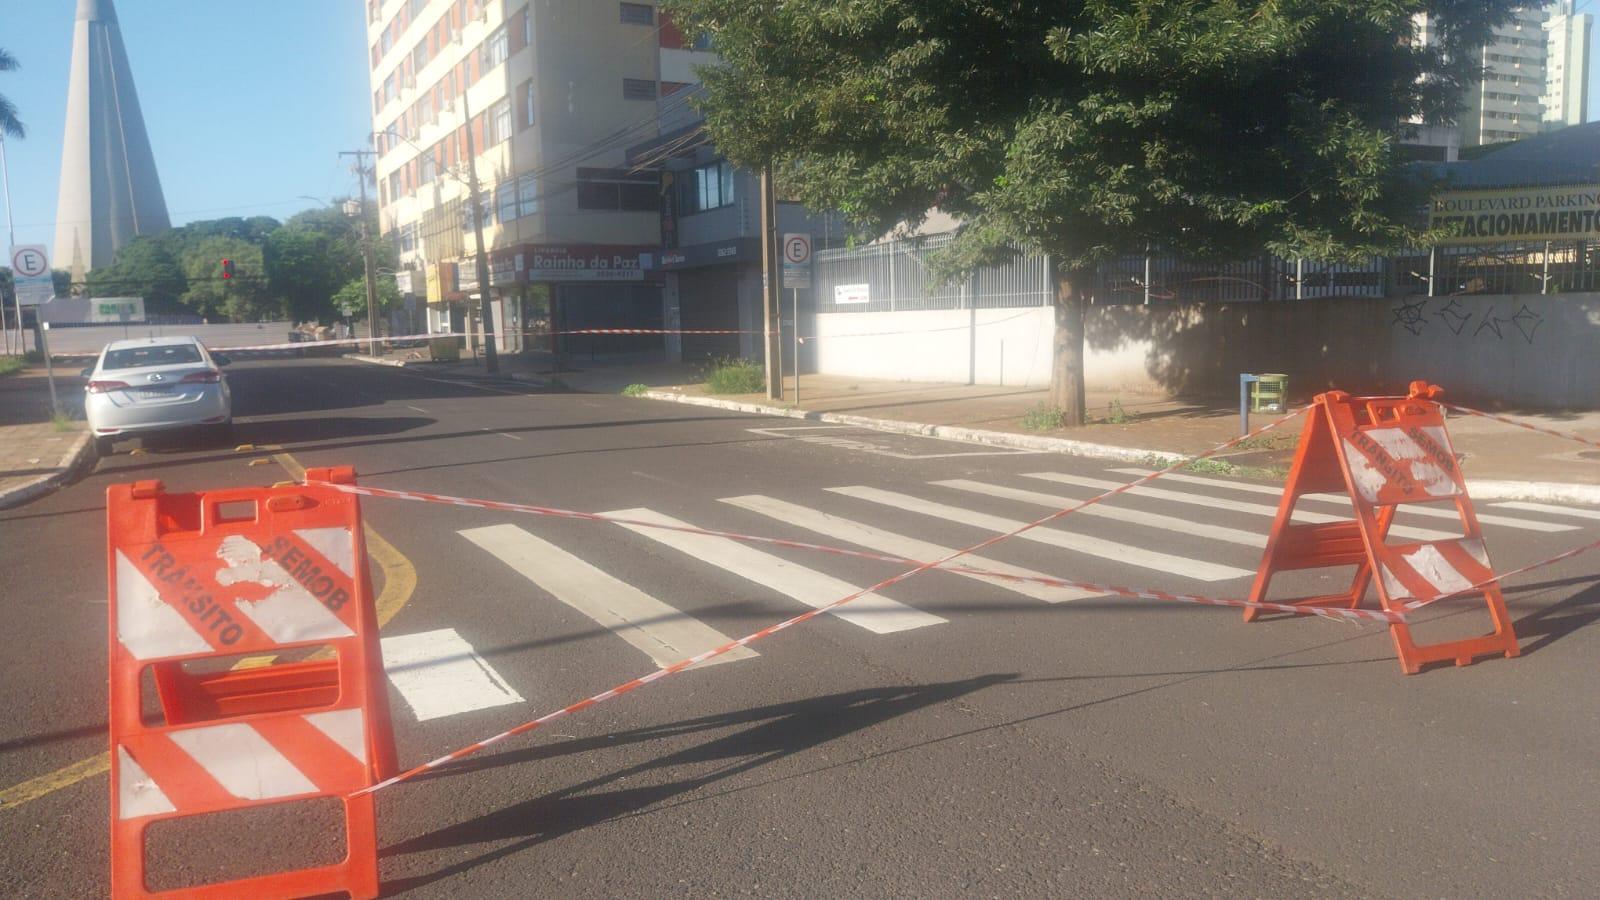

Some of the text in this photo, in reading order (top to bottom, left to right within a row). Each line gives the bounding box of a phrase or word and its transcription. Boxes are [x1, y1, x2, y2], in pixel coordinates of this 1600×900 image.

[1434, 192, 1600, 212] BOULEVARD PARKIN
[793, 242, 801, 257] E
[24, 254, 37, 271] E
[534, 255, 638, 268] Rainha da Paz
[1408, 427, 1454, 472] SEMOB
